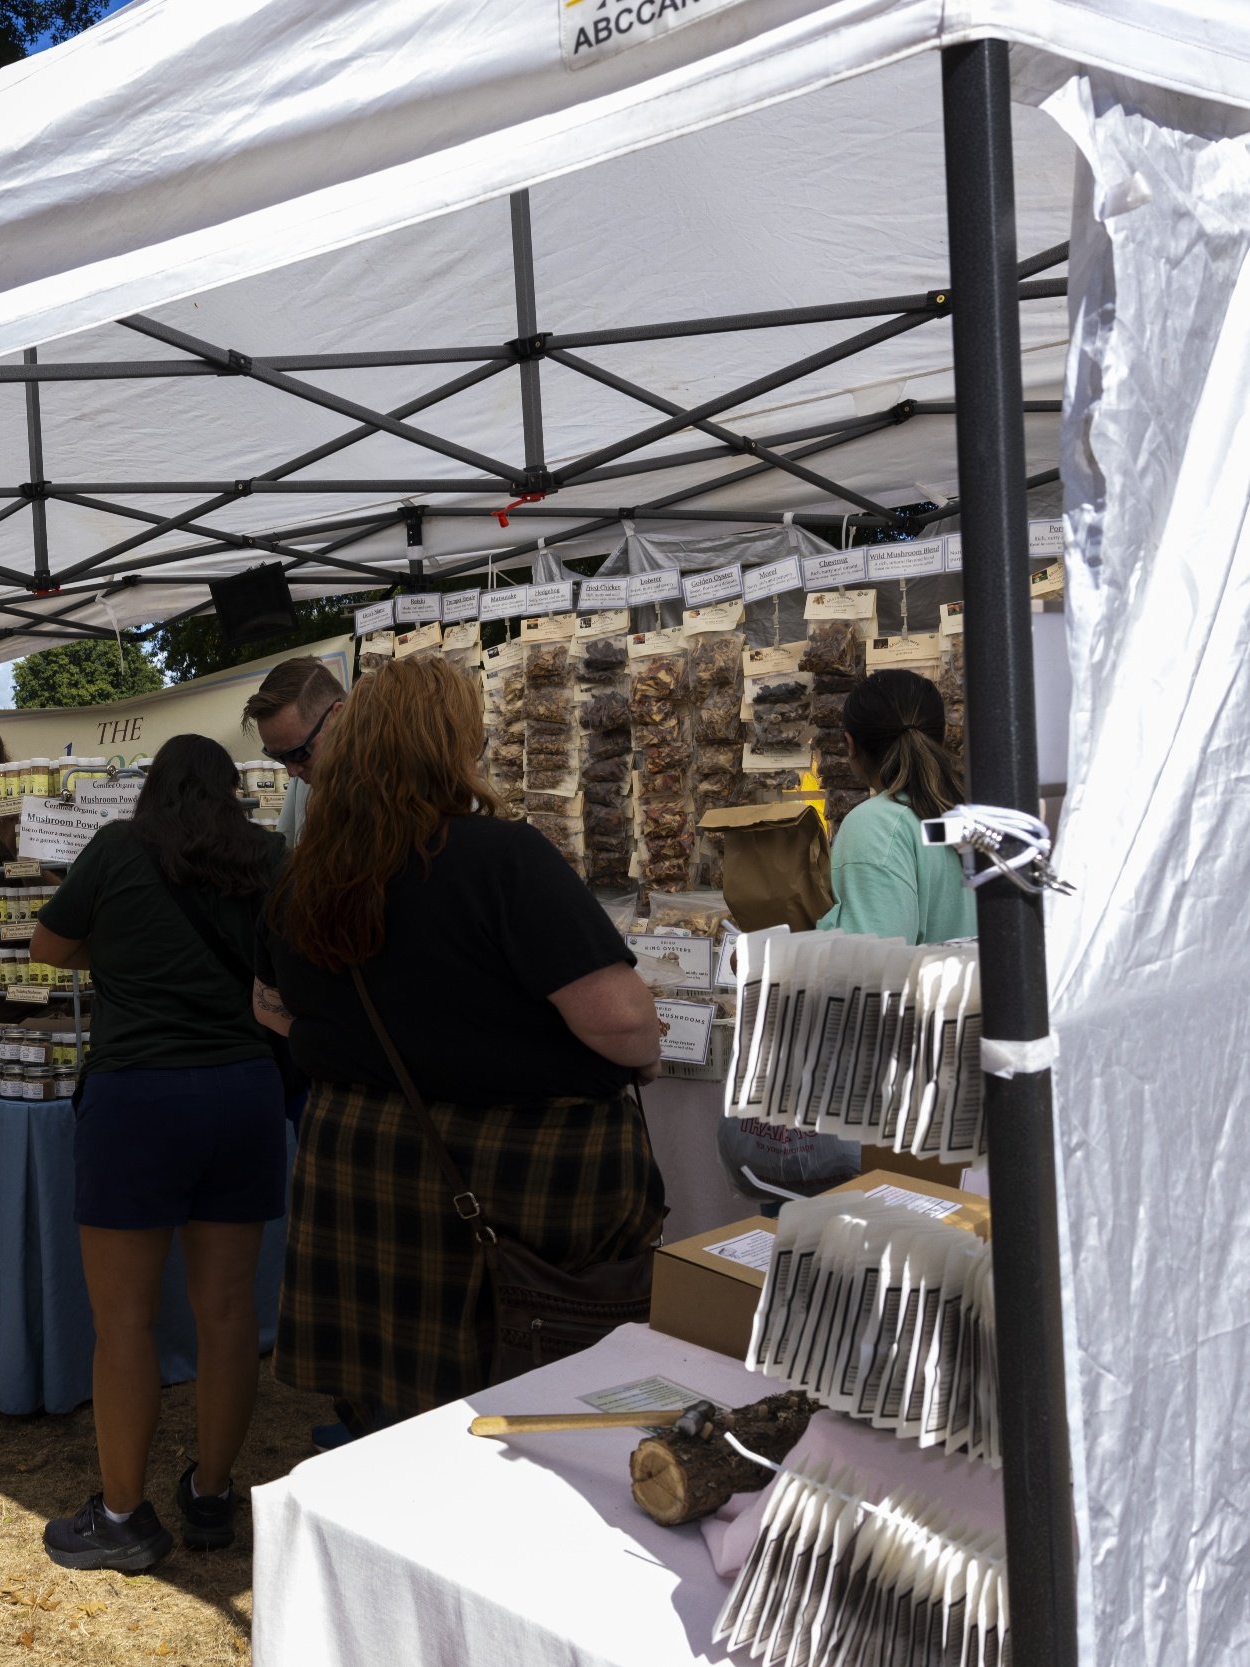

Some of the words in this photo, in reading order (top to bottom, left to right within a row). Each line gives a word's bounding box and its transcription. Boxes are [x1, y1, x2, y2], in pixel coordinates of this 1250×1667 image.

[870, 553, 885, 561] Wild
[886, 550, 923, 559] Mushroom
[924, 546, 940, 554] Blend
[819, 557, 848, 567] Chestnut
[759, 568, 778, 578] Morel
[640, 576, 662, 585] Lobster
[691, 577, 713, 587] Golden
[714, 571, 734, 582] Oyster
[97, 717, 143, 745] THE
[92, 780, 115, 789] Certified
[116, 782, 136, 790] Organic
[80, 796, 117, 804] Mushroom
[74, 806, 98, 816] Organic
[27, 813, 74, 827] Mushroom
[76, 820, 103, 830] Powde
[660, 1013, 705, 1025] MUSHROOMS
